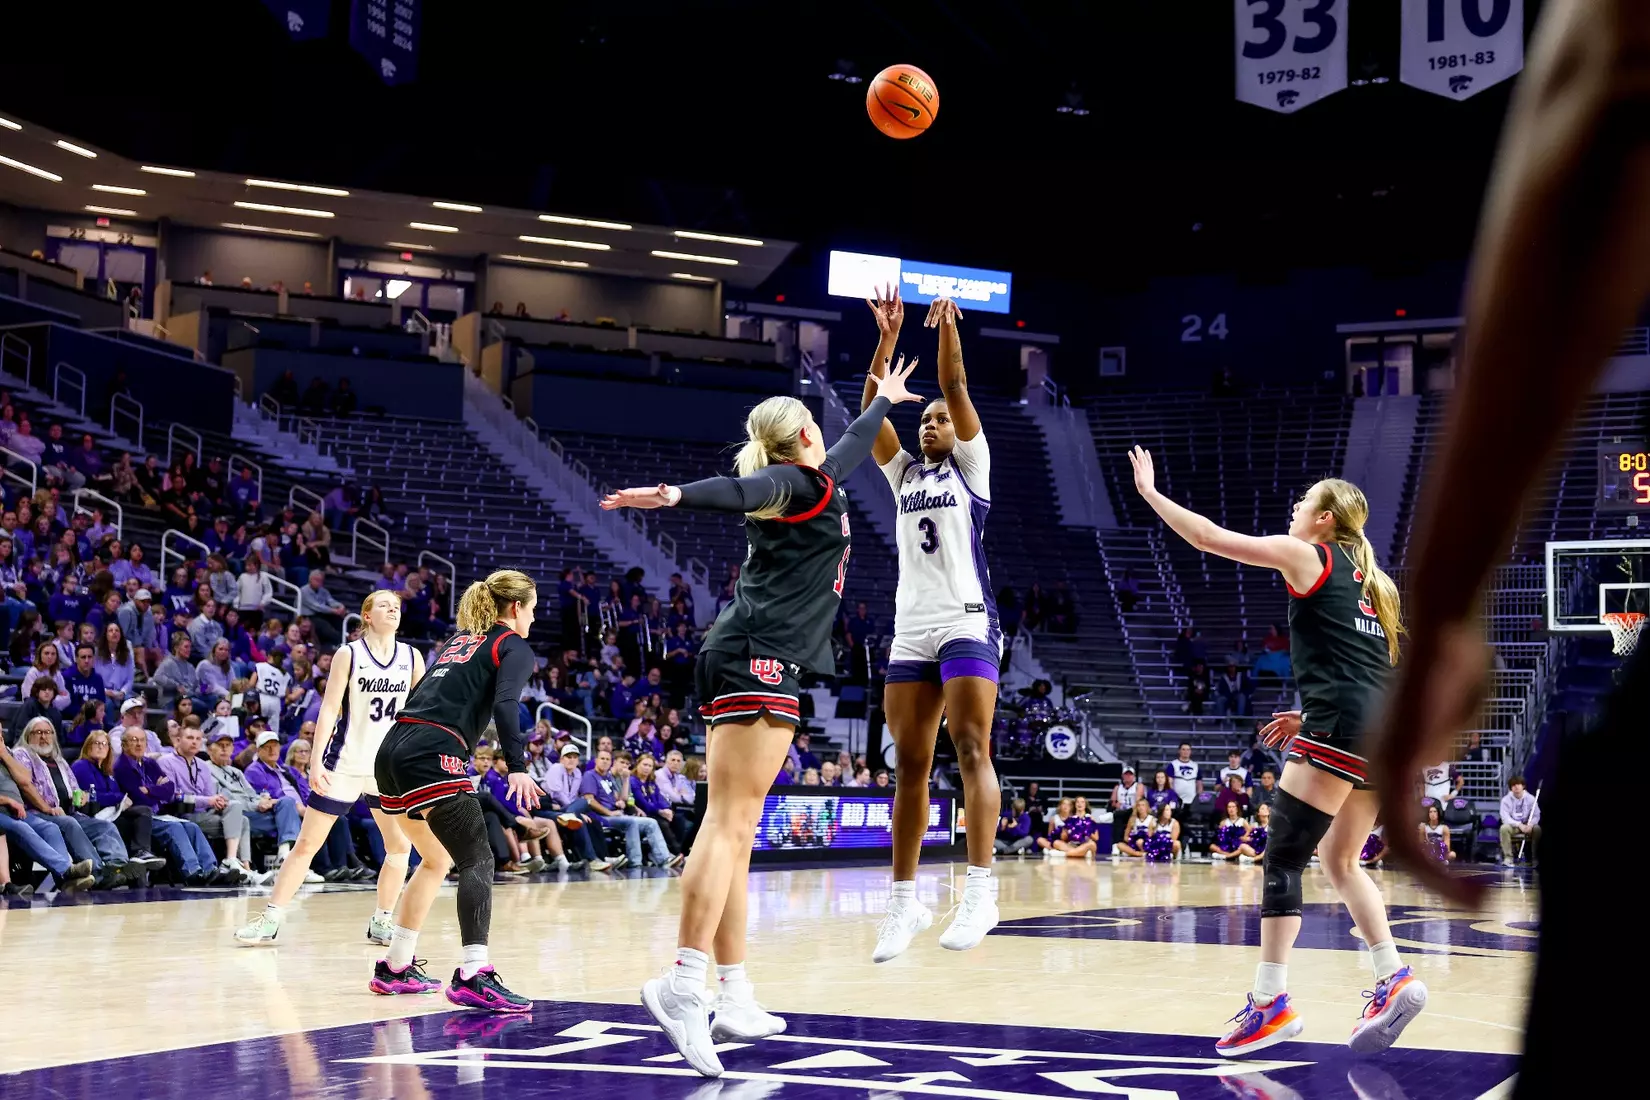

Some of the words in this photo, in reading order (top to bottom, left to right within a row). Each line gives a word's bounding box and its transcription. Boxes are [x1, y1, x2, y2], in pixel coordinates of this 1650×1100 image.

[1241, 0, 1338, 59] 33
[1257, 66, 1322, 85] 1979-82
[1428, 50, 1496, 71] 1981-83
[898, 72, 933, 103] ELITE
[1181, 312, 1230, 342] 24
[900, 489, 958, 516] Wildcats
[918, 516, 940, 555] 3
[436, 634, 488, 665] 23
[369, 696, 397, 723] 34
